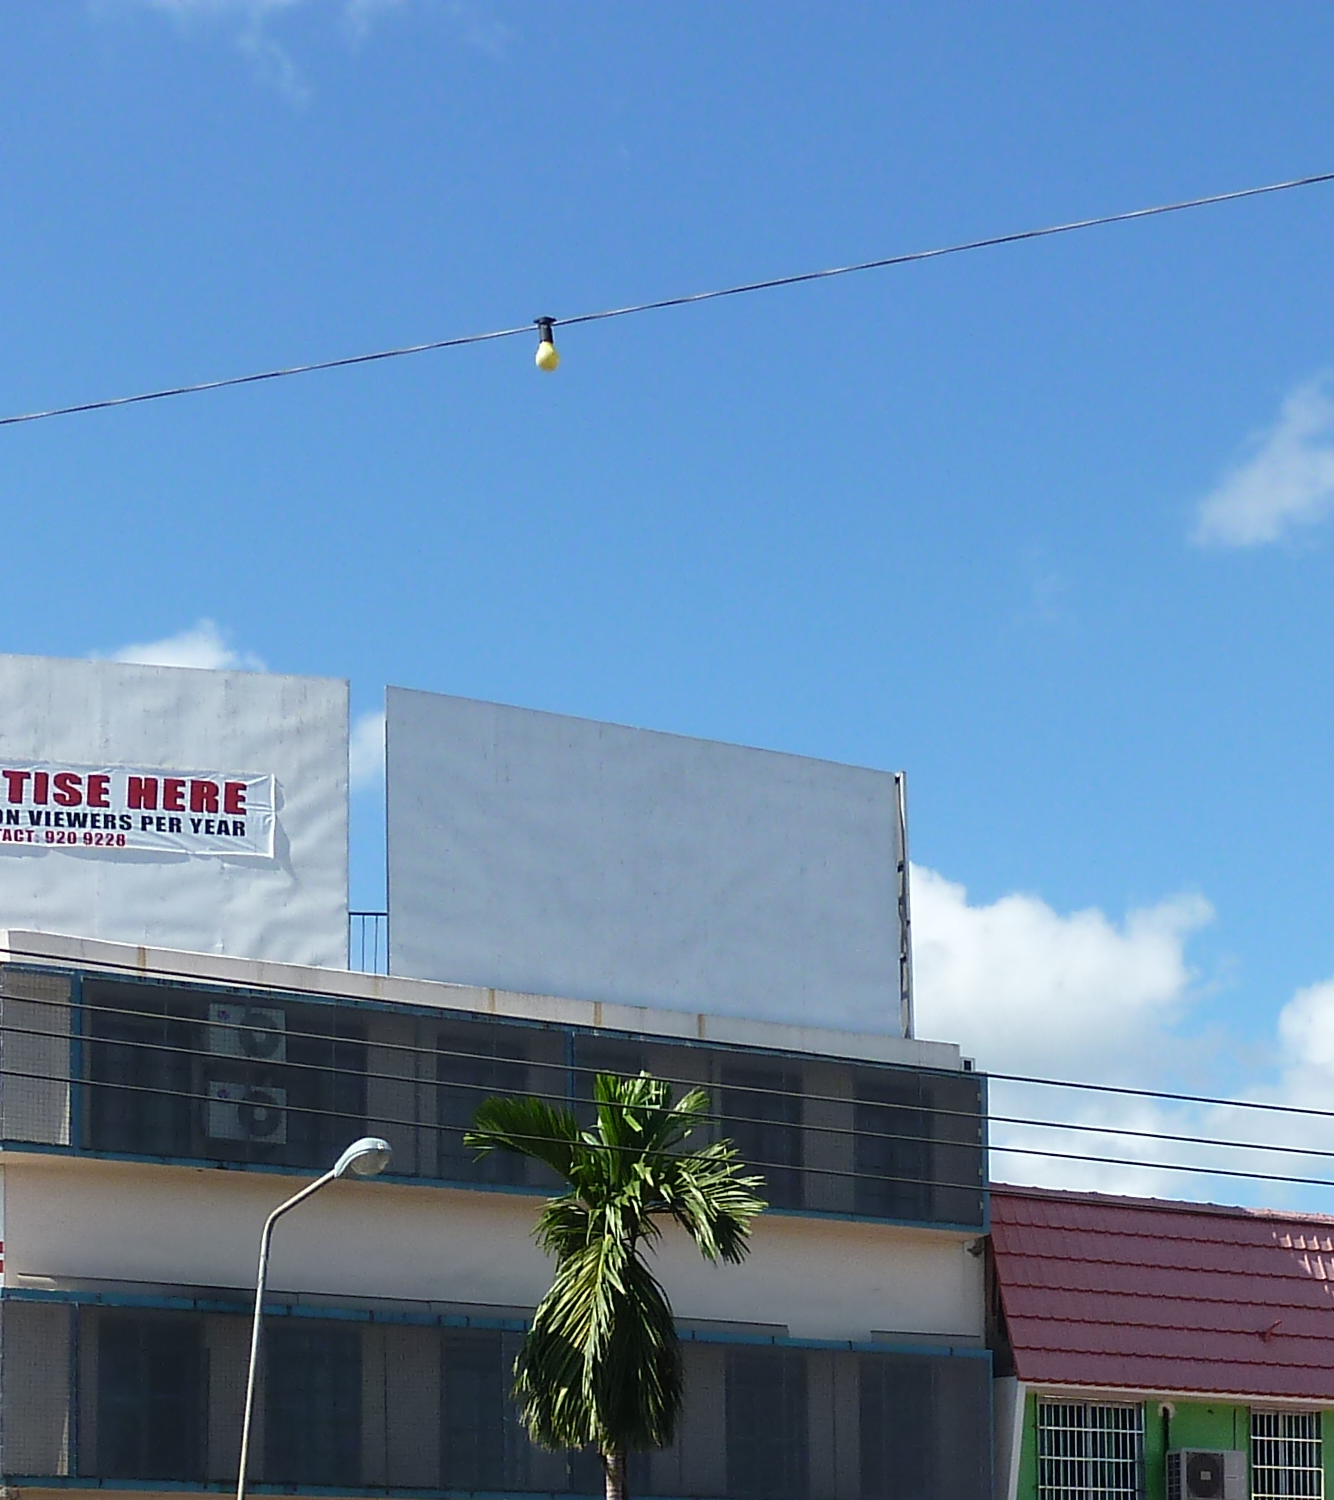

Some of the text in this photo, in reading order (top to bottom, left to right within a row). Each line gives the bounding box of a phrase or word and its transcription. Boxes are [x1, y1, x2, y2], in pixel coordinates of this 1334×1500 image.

[127, 776, 247, 815] HERE
[29, 810, 132, 830] VIEWERS
[141, 815, 181, 834] PER
[189, 818, 246, 836] YEAR
[45, 830, 77, 844] 920
[83, 832, 126, 846] 9228
